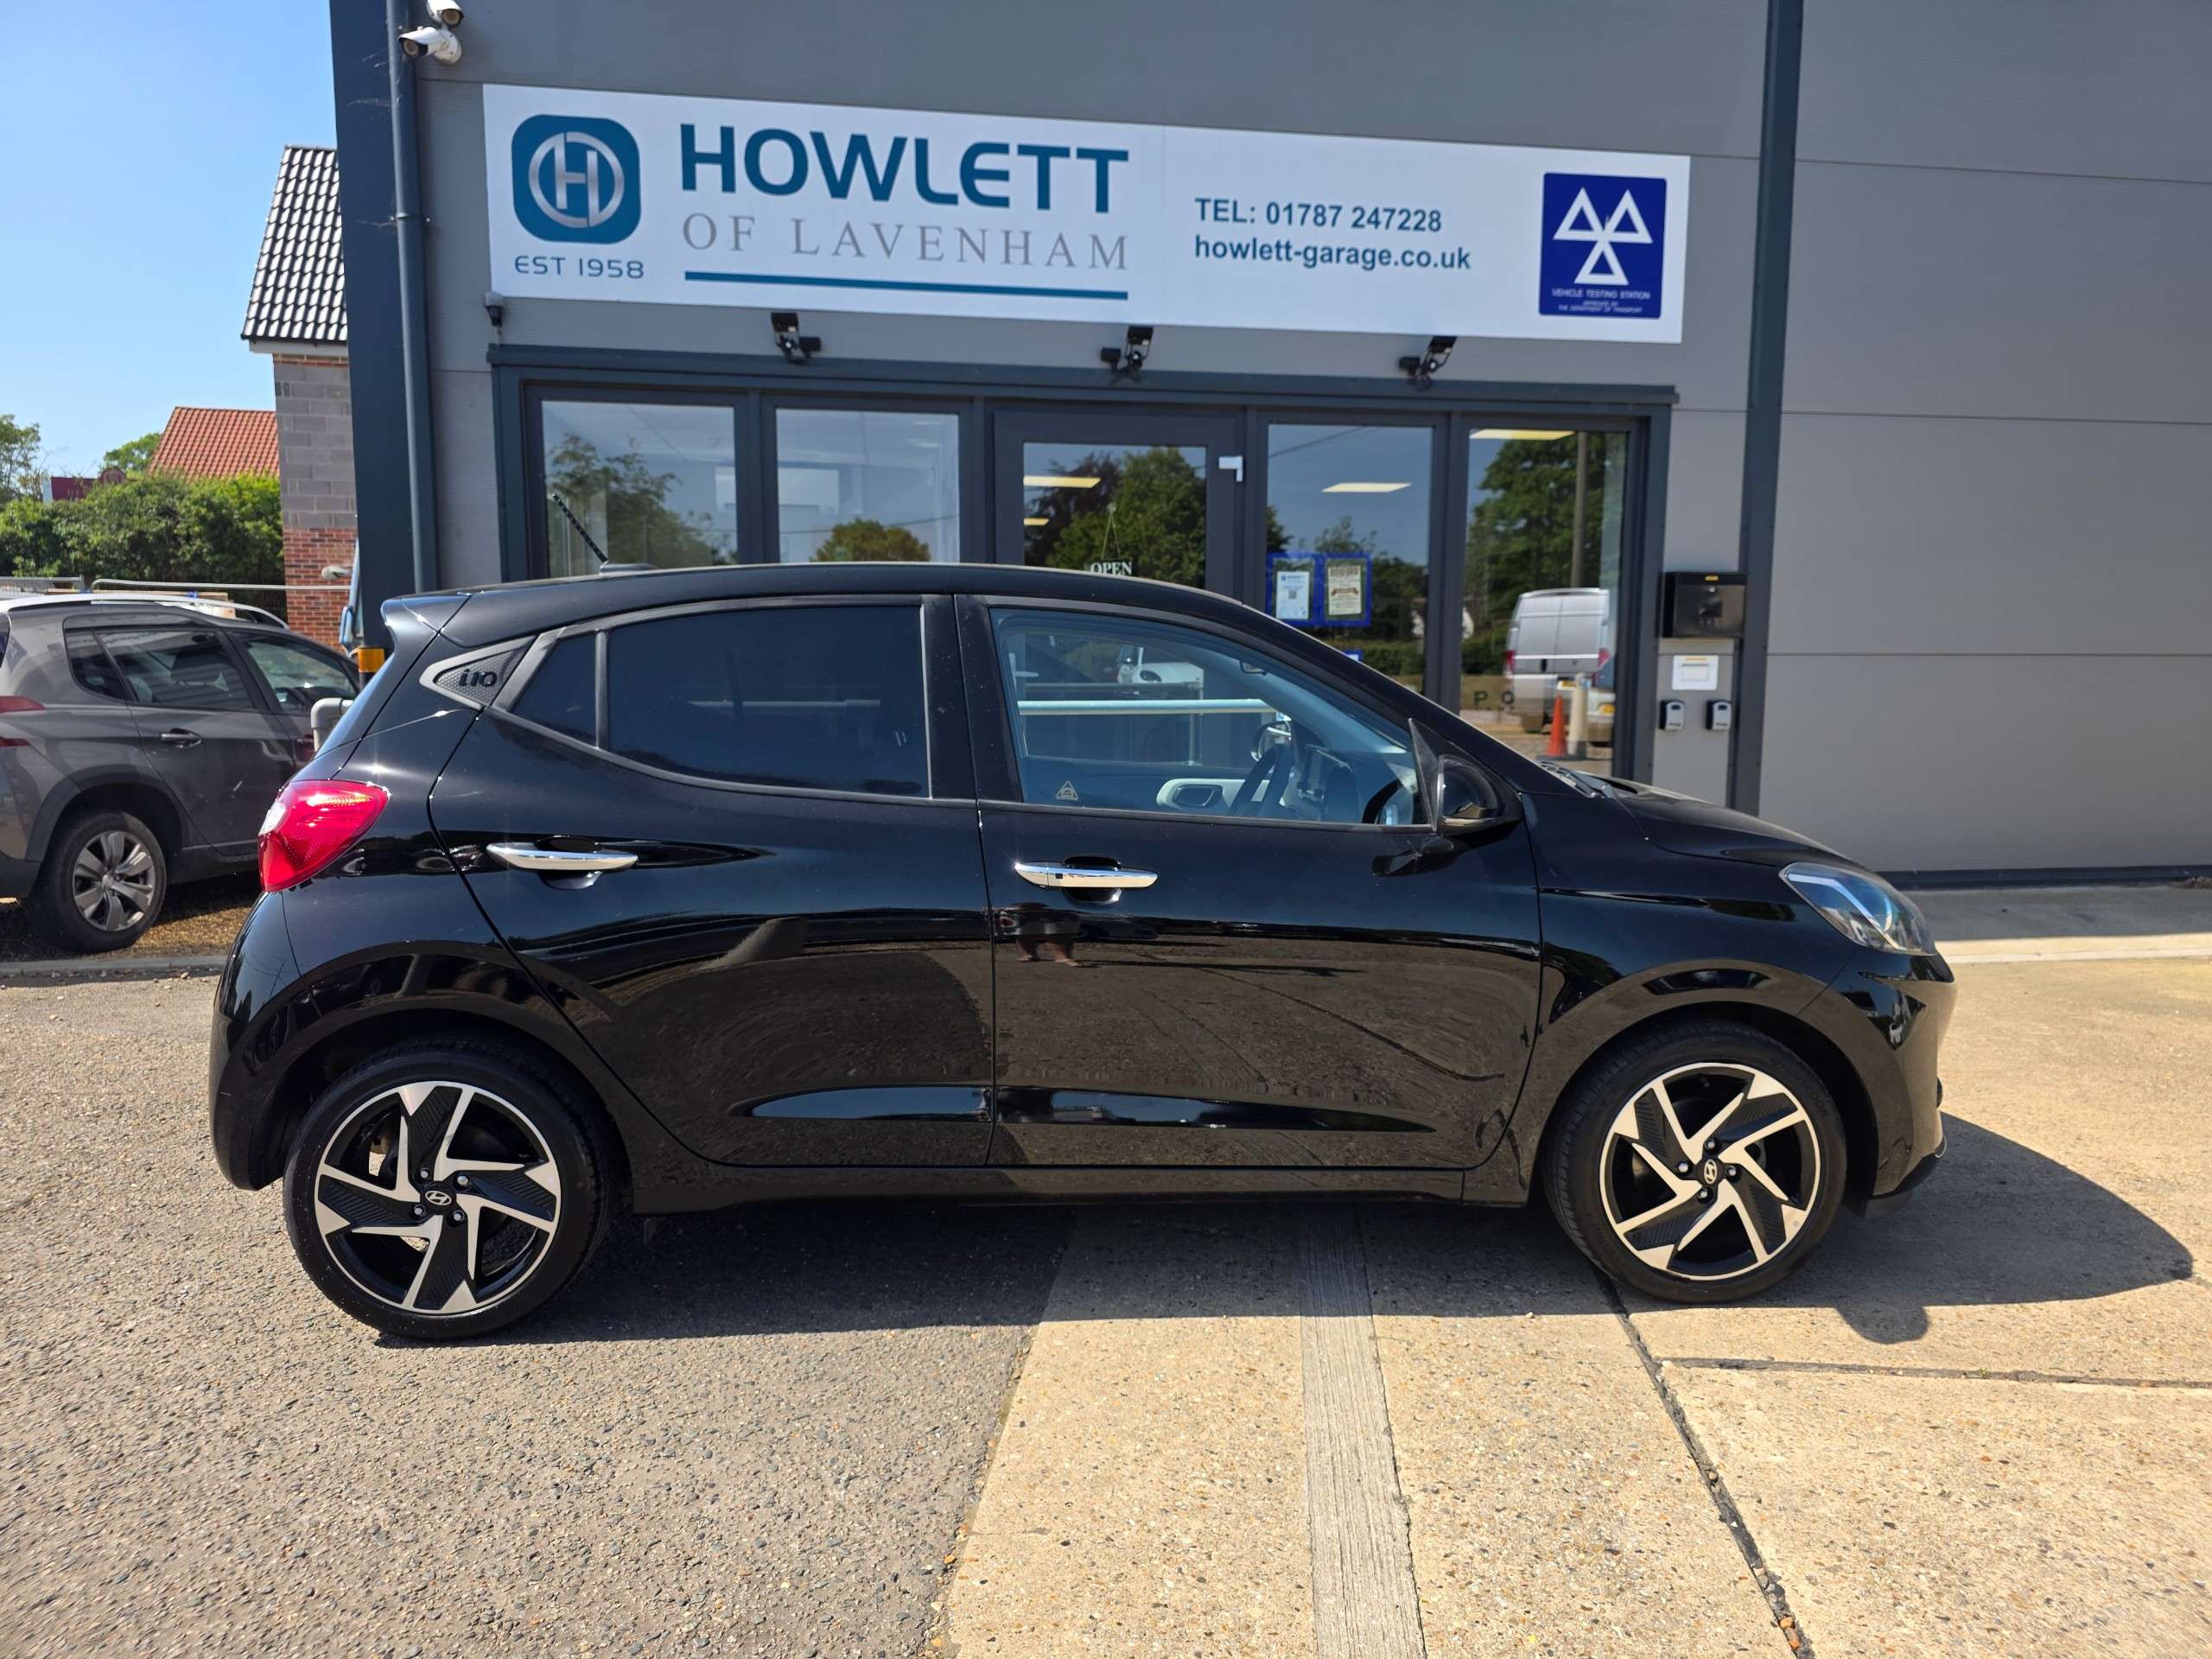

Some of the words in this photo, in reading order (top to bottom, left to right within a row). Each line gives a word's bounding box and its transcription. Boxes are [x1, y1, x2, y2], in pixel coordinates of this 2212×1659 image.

[680, 123, 1129, 213] HOWLETT
[1194, 197, 1255, 224] TEL:
[1266, 201, 1343, 228] 01787
[1351, 206, 1442, 233] 247228
[682, 213, 756, 252] OF
[791, 218, 1128, 270] LAVENHAM
[1195, 233, 1471, 273] howlett-garage.co.uk
[514, 255, 567, 276] EST
[578, 257, 645, 280] 1958
[1090, 562, 1133, 576] OPEN
